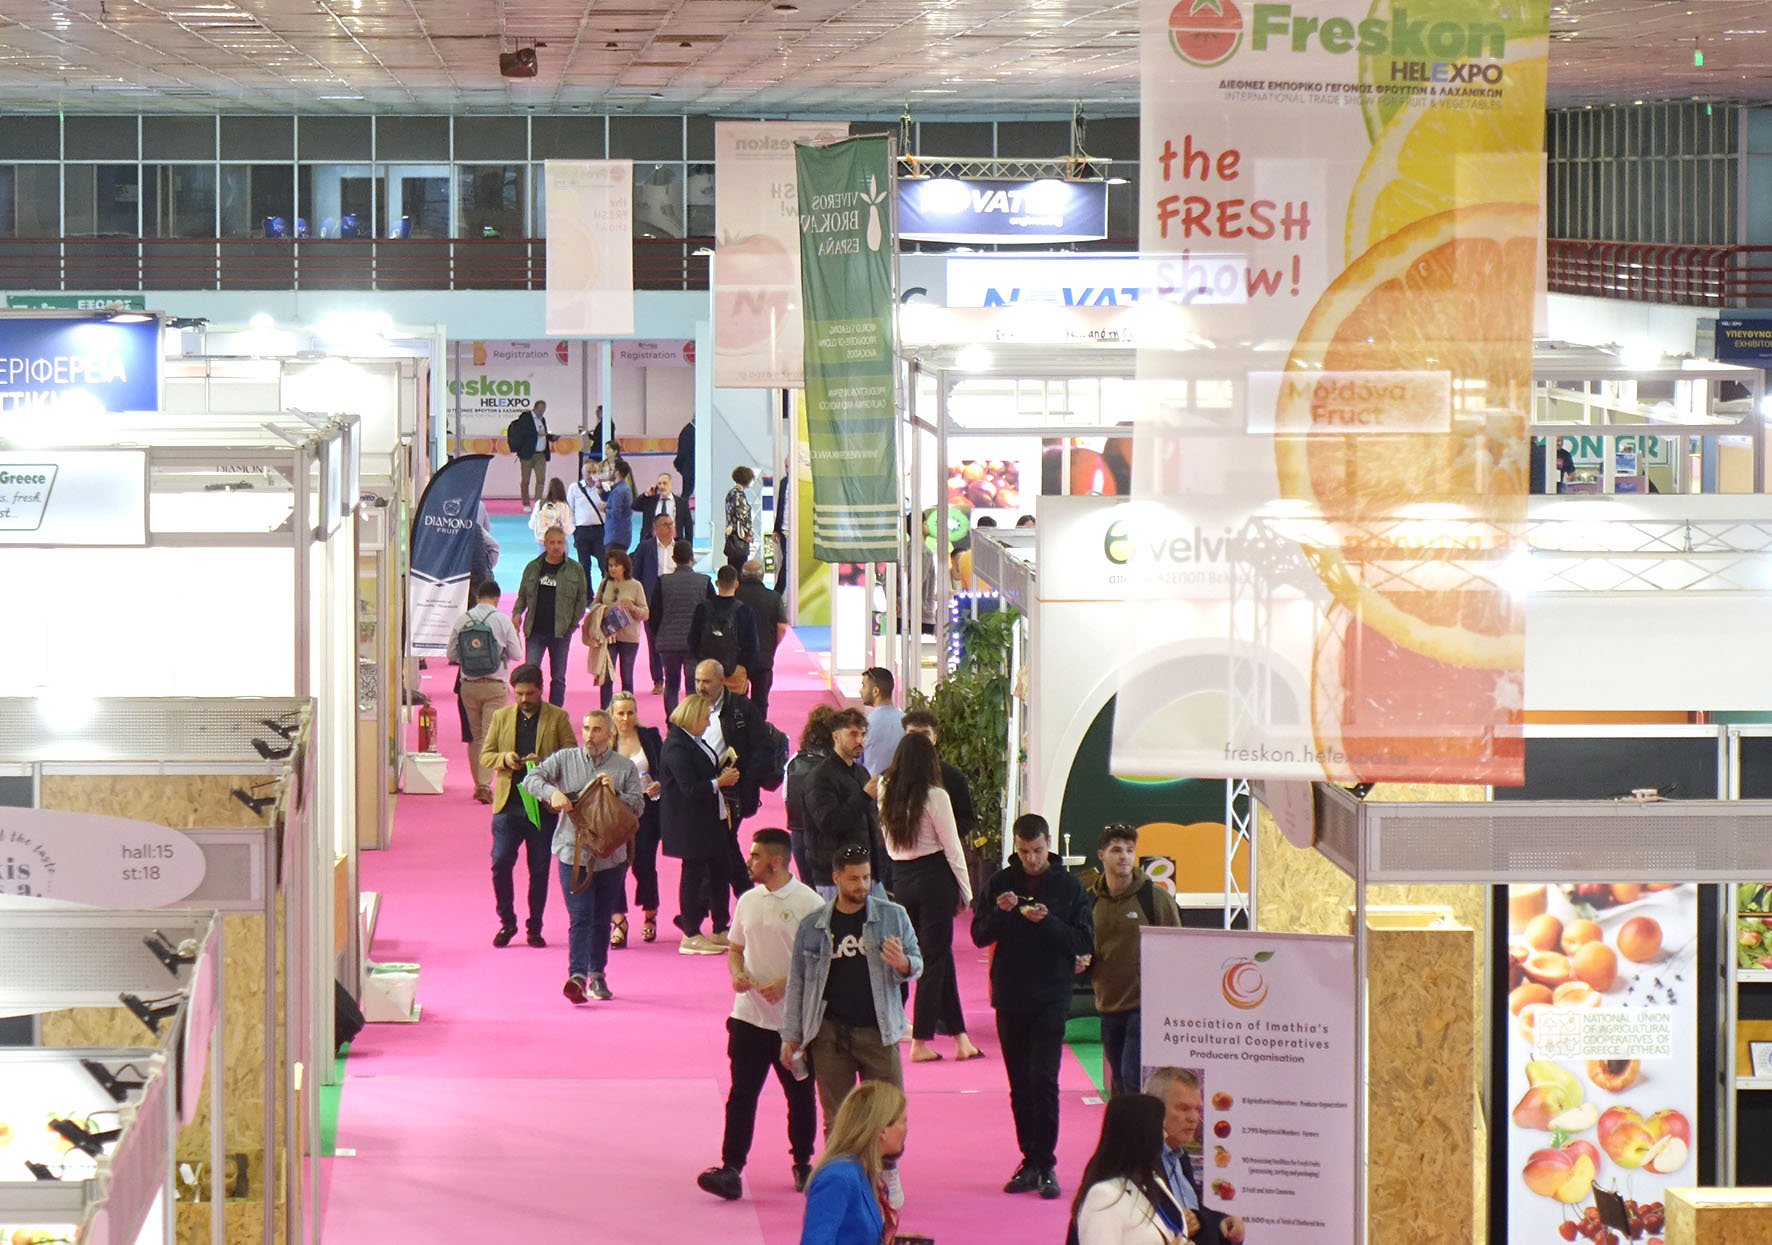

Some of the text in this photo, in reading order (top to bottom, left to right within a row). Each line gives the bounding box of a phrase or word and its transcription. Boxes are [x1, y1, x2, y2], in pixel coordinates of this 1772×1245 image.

[1251, 2, 1507, 59] Freskon
[1390, 61, 1504, 85] HELEXPO
[1218, 79, 1266, 91] ΔΙΕΘΝΕΣ
[1267, 81, 1323, 92] ΕΜΠΟΡΙΚΟ
[1325, 83, 1374, 94] ΓΕΓΟΝΟΣ
[1376, 85, 1427, 96] ΦΡΟΥΤΩΝ
[1439, 87, 1503, 98] ΛΑΧΑΝΙΚΩΝ
[1224, 91, 1305, 104] INTERNATIONAL
[1309, 94, 1341, 105] TRADE
[1158, 134, 1240, 182] the
[1157, 194, 1311, 242] FRESH
[1156, 248, 1300, 298] show!
[493, 349, 549, 361] Registration
[620, 350, 676, 361] Registration
[447, 375, 531, 396] eskon
[1288, 380, 1407, 401] Moldova
[480, 398, 530, 408] HELEXPO
[1311, 404, 1383, 425] Fruct
[216, 464, 266, 474] DIAMON
[0, 471, 46, 484] Greece
[425, 515, 473, 529] DIAMOND
[122, 845, 174, 859] hall:15
[122, 865, 161, 880] st:18
[1583, 1012, 1670, 1023] NATIONAL UNION
[1163, 1017, 1329, 1034] Association of Imathia's
[1583, 1024, 1670, 1034] OF AGRICULTURAL
[1163, 1032, 1330, 1049] Agricultural Cooperatives
[1583, 1034, 1670, 1044] COOPERATIVES OF
[1190, 1050, 1305, 1064] Producers Organisation
[1583, 1045, 1670, 1056] GREECE (ETHEAS)
